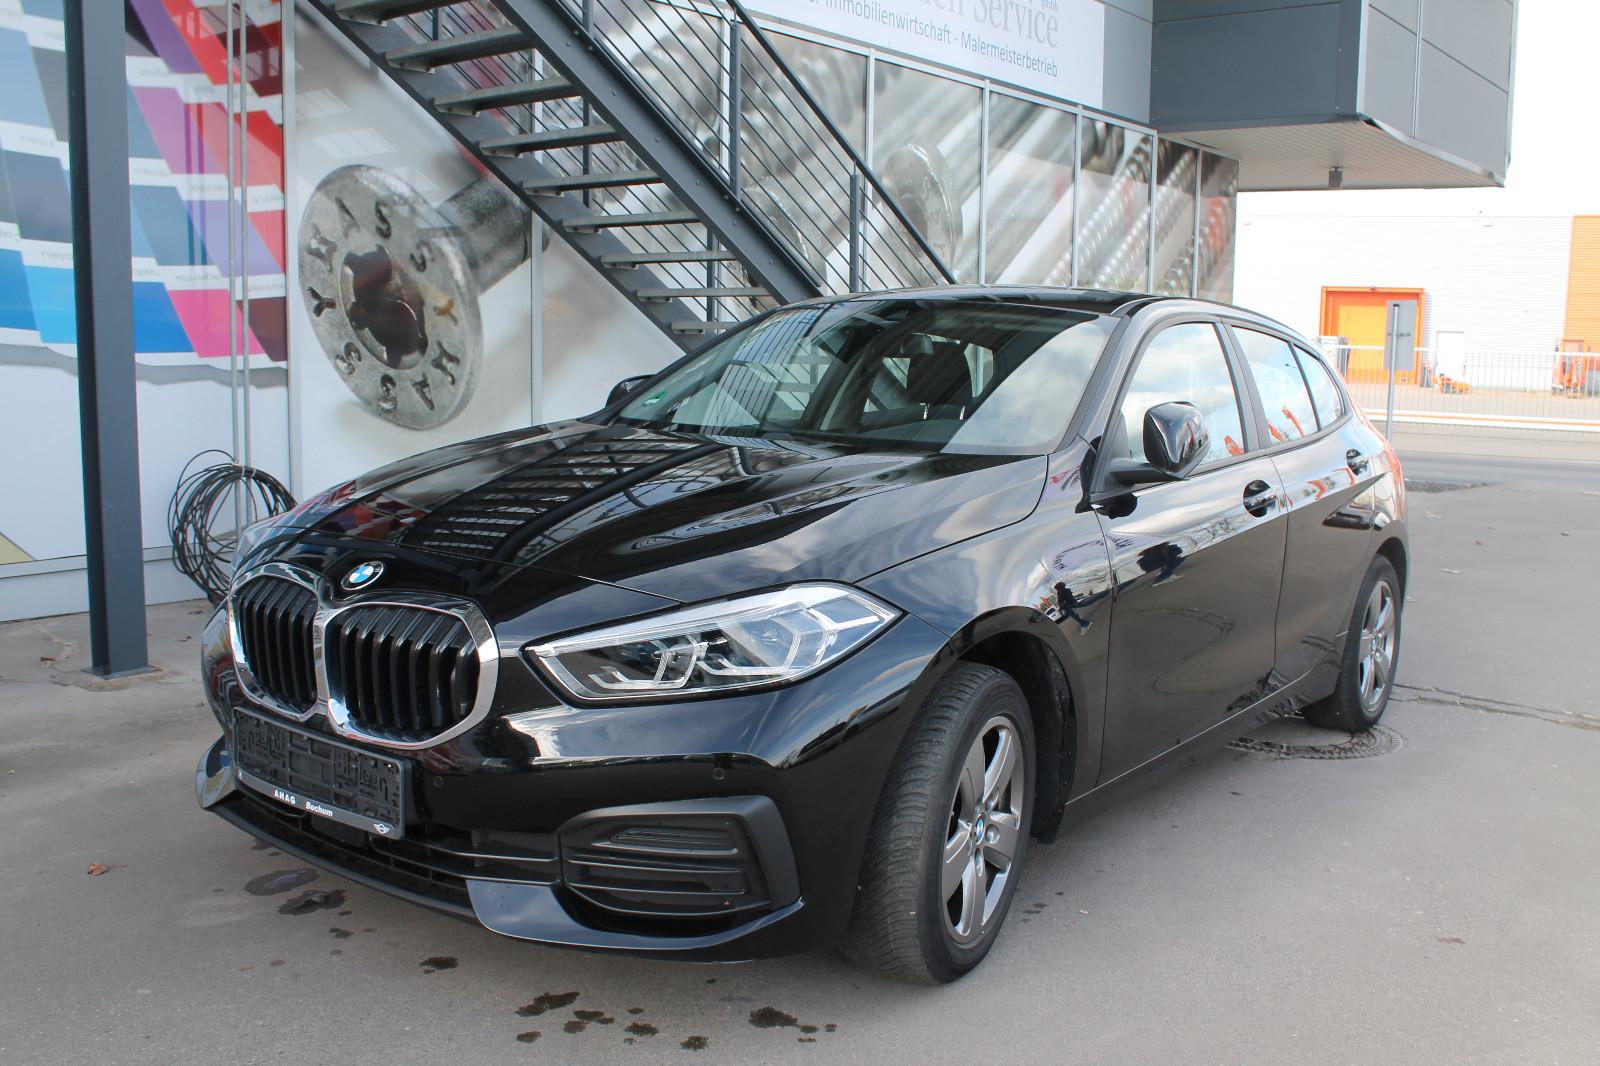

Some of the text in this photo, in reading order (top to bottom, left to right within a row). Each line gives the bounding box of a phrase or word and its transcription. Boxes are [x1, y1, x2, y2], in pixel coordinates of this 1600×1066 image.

[974, 0, 1058, 47] Service
[961, 31, 1058, 78] Malermeisterbetrieb
[305, 801, 333, 817] Bochum
